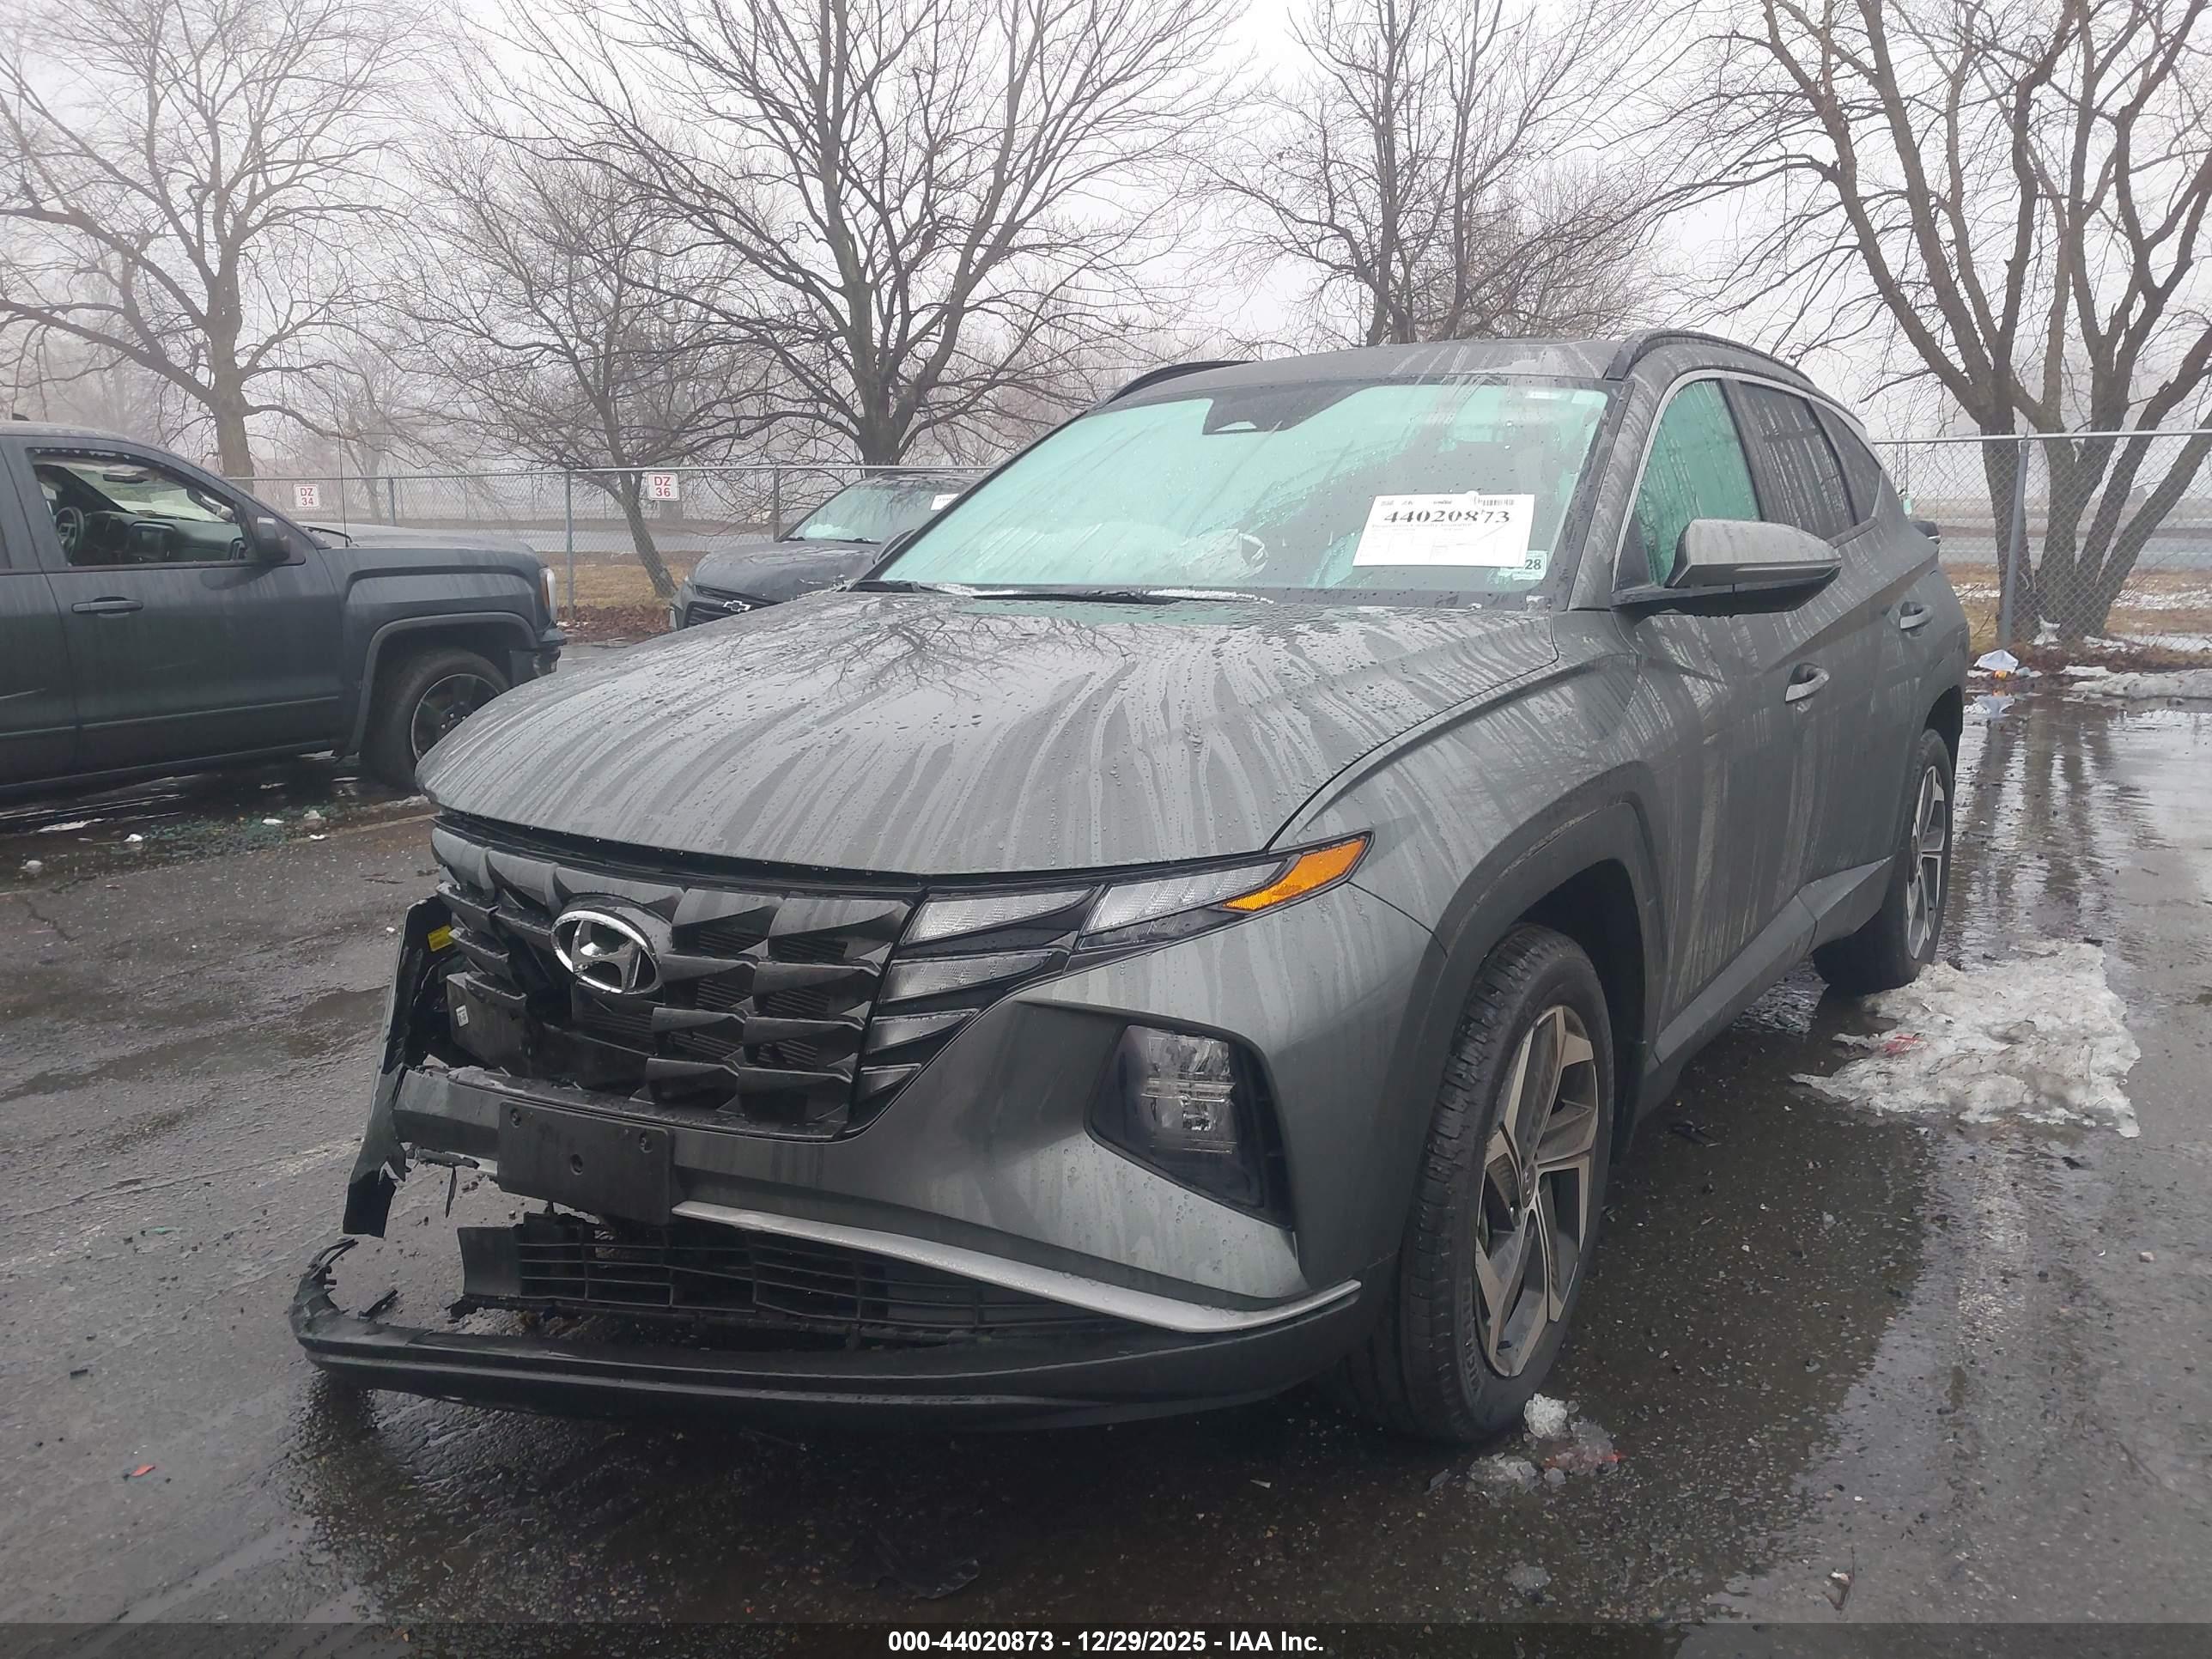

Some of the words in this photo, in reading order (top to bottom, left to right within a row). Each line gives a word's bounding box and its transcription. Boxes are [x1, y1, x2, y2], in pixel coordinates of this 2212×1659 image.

[654, 476, 672, 487] DZ
[300, 487, 314, 496] DZ
[655, 487, 672, 497] 36
[301, 497, 314, 507] 34
[1383, 509, 1510, 524] 44020873
[1524, 558, 1542, 570] 28
